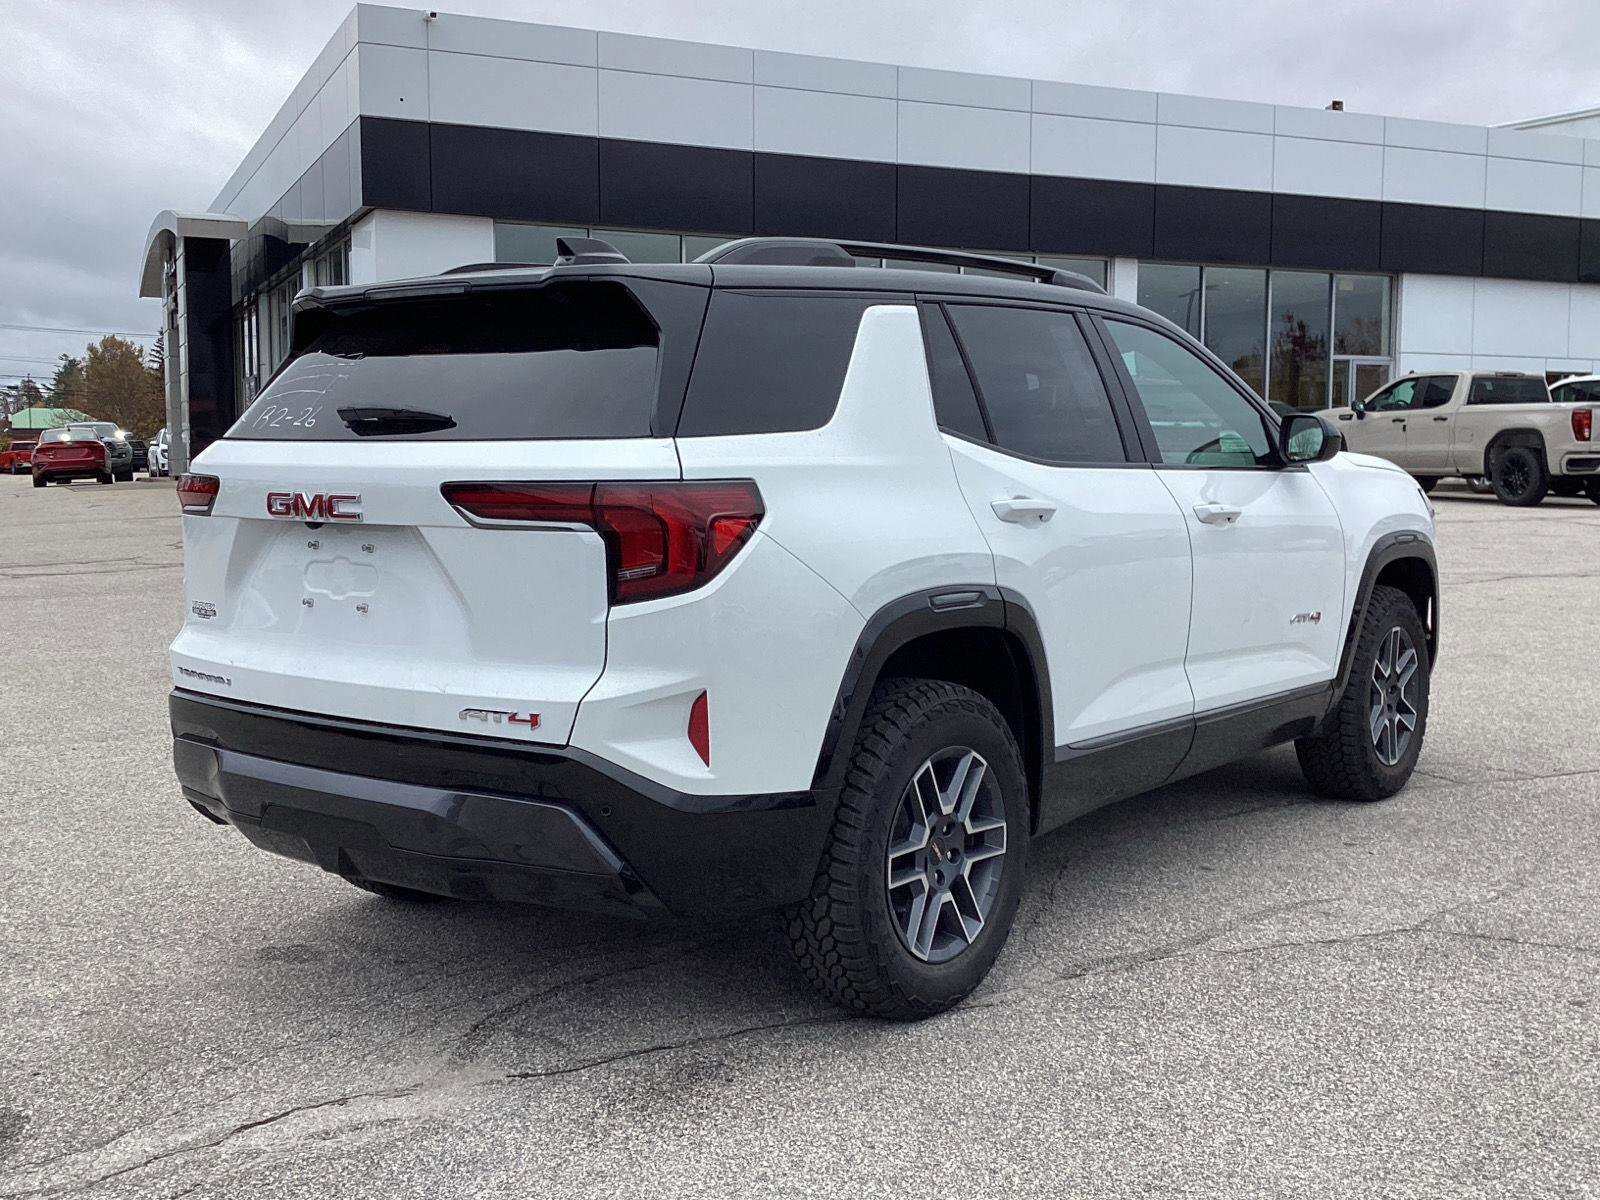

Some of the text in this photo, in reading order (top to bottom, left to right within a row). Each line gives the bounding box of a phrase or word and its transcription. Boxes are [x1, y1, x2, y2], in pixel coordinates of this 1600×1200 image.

[266, 491, 362, 522] GMC
[1289, 611, 1321, 625] AT4
[459, 708, 541, 731] AT4
